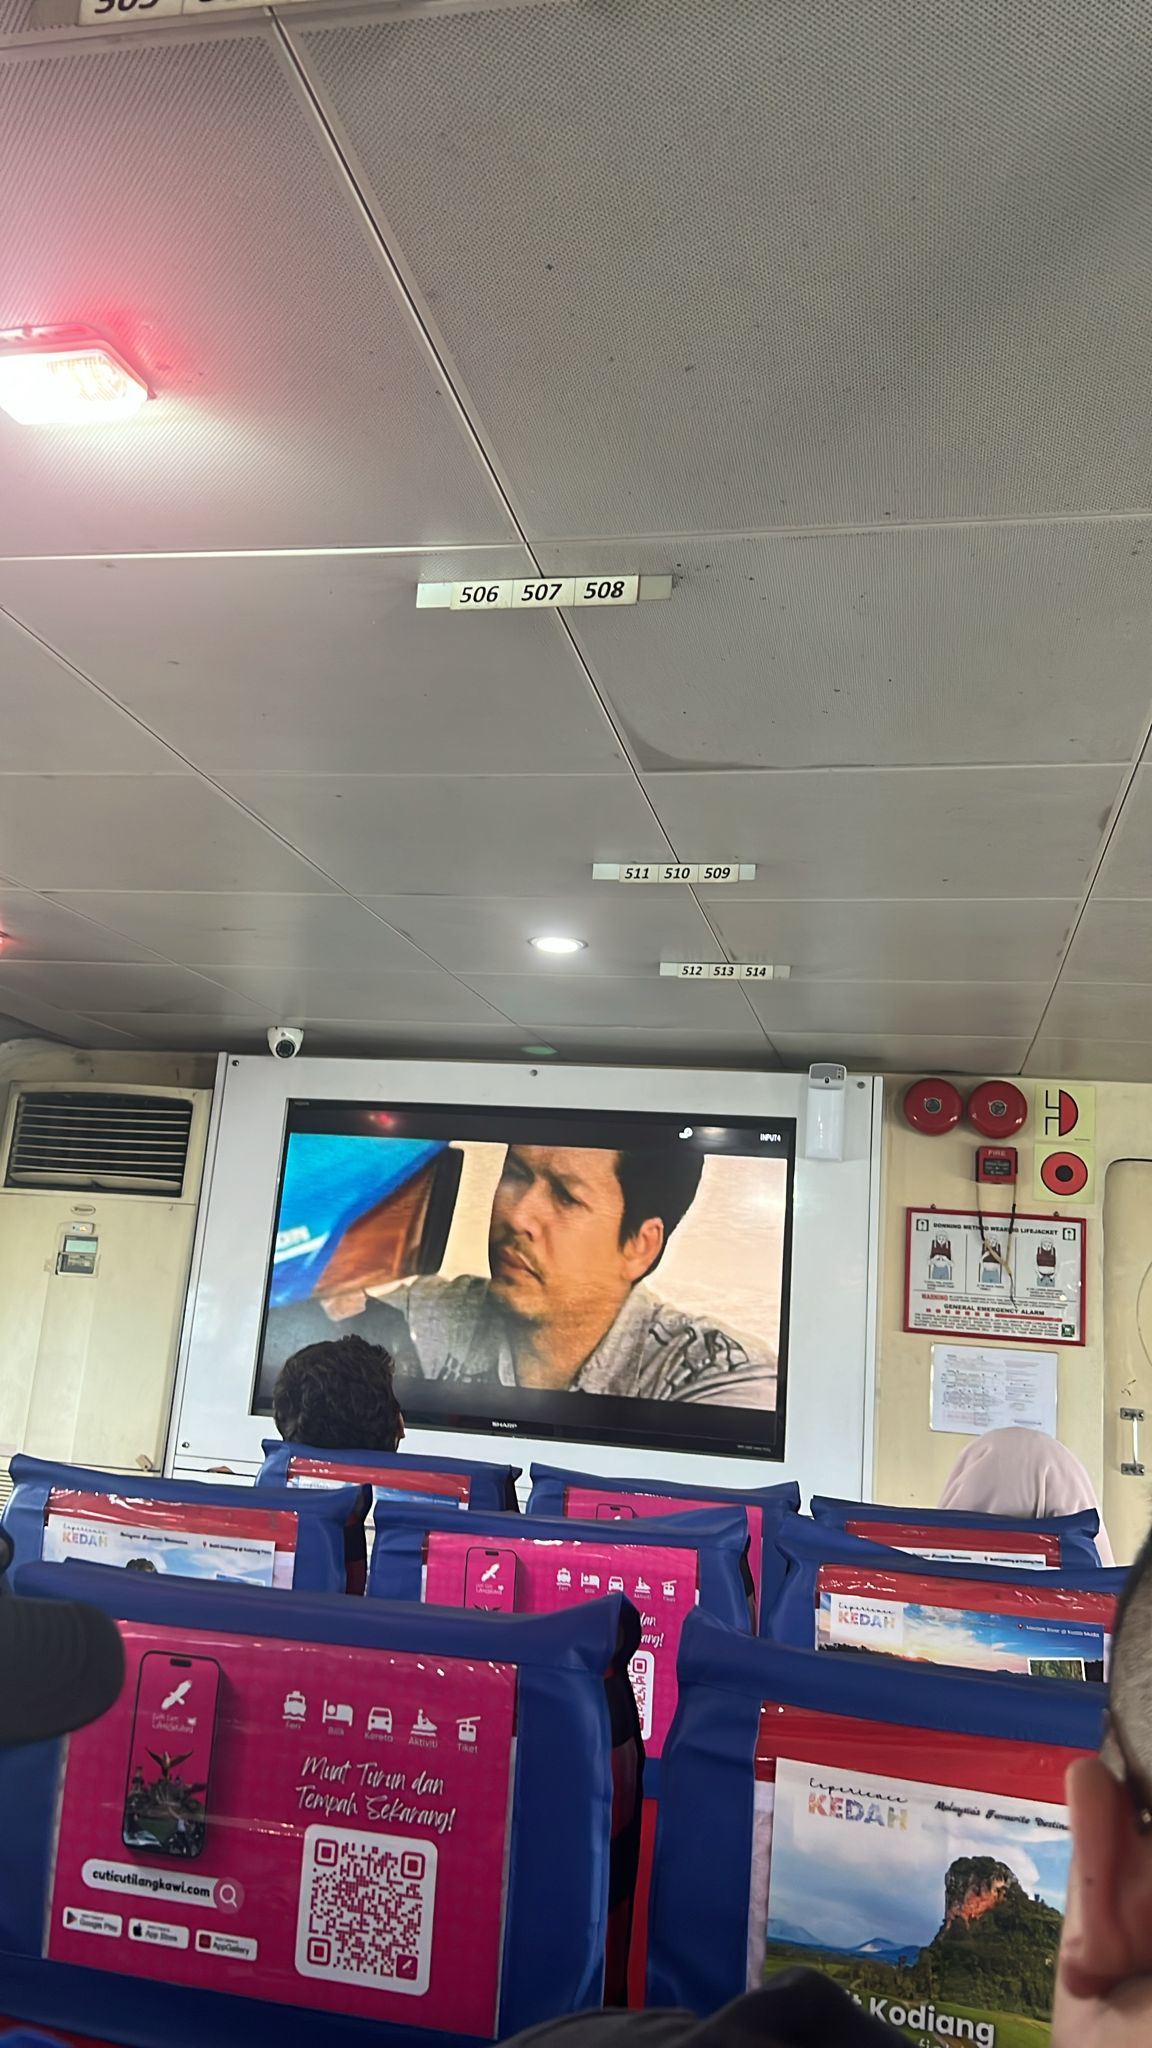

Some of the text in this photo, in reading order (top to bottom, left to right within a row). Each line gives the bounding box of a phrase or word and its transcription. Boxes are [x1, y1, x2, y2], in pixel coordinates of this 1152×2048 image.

[459, 581, 625, 603] 506 507 508
[624, 866, 731, 880] 511 510 509
[681, 965, 767, 978] 512 513 514
[760, 1133, 782, 1142] INPUT4
[963, 1223, 990, 1232] METHD
[1020, 1227, 1059, 1236] LIFEJACKET
[943, 1303, 1045, 1316] GENERAL EMERGENCY ALARM
[491, 1421, 518, 1429] SHARP
[62, 1531, 109, 1548] KEDAH
[838, 1610, 897, 1629] KEDAH
[364, 1732, 394, 1743] Kereta
[408, 1736, 438, 1748] Aktiviti
[457, 1743, 478, 1753] Tiket
[301, 1756, 444, 1796] Muat Turun dan
[295, 1784, 457, 1835] Tempah Sekarang!
[808, 1792, 909, 1831] KEDAH
[92, 1869, 211, 1898] cuticutilangkawi.com
[869, 1996, 995, 2048] Kodiang
